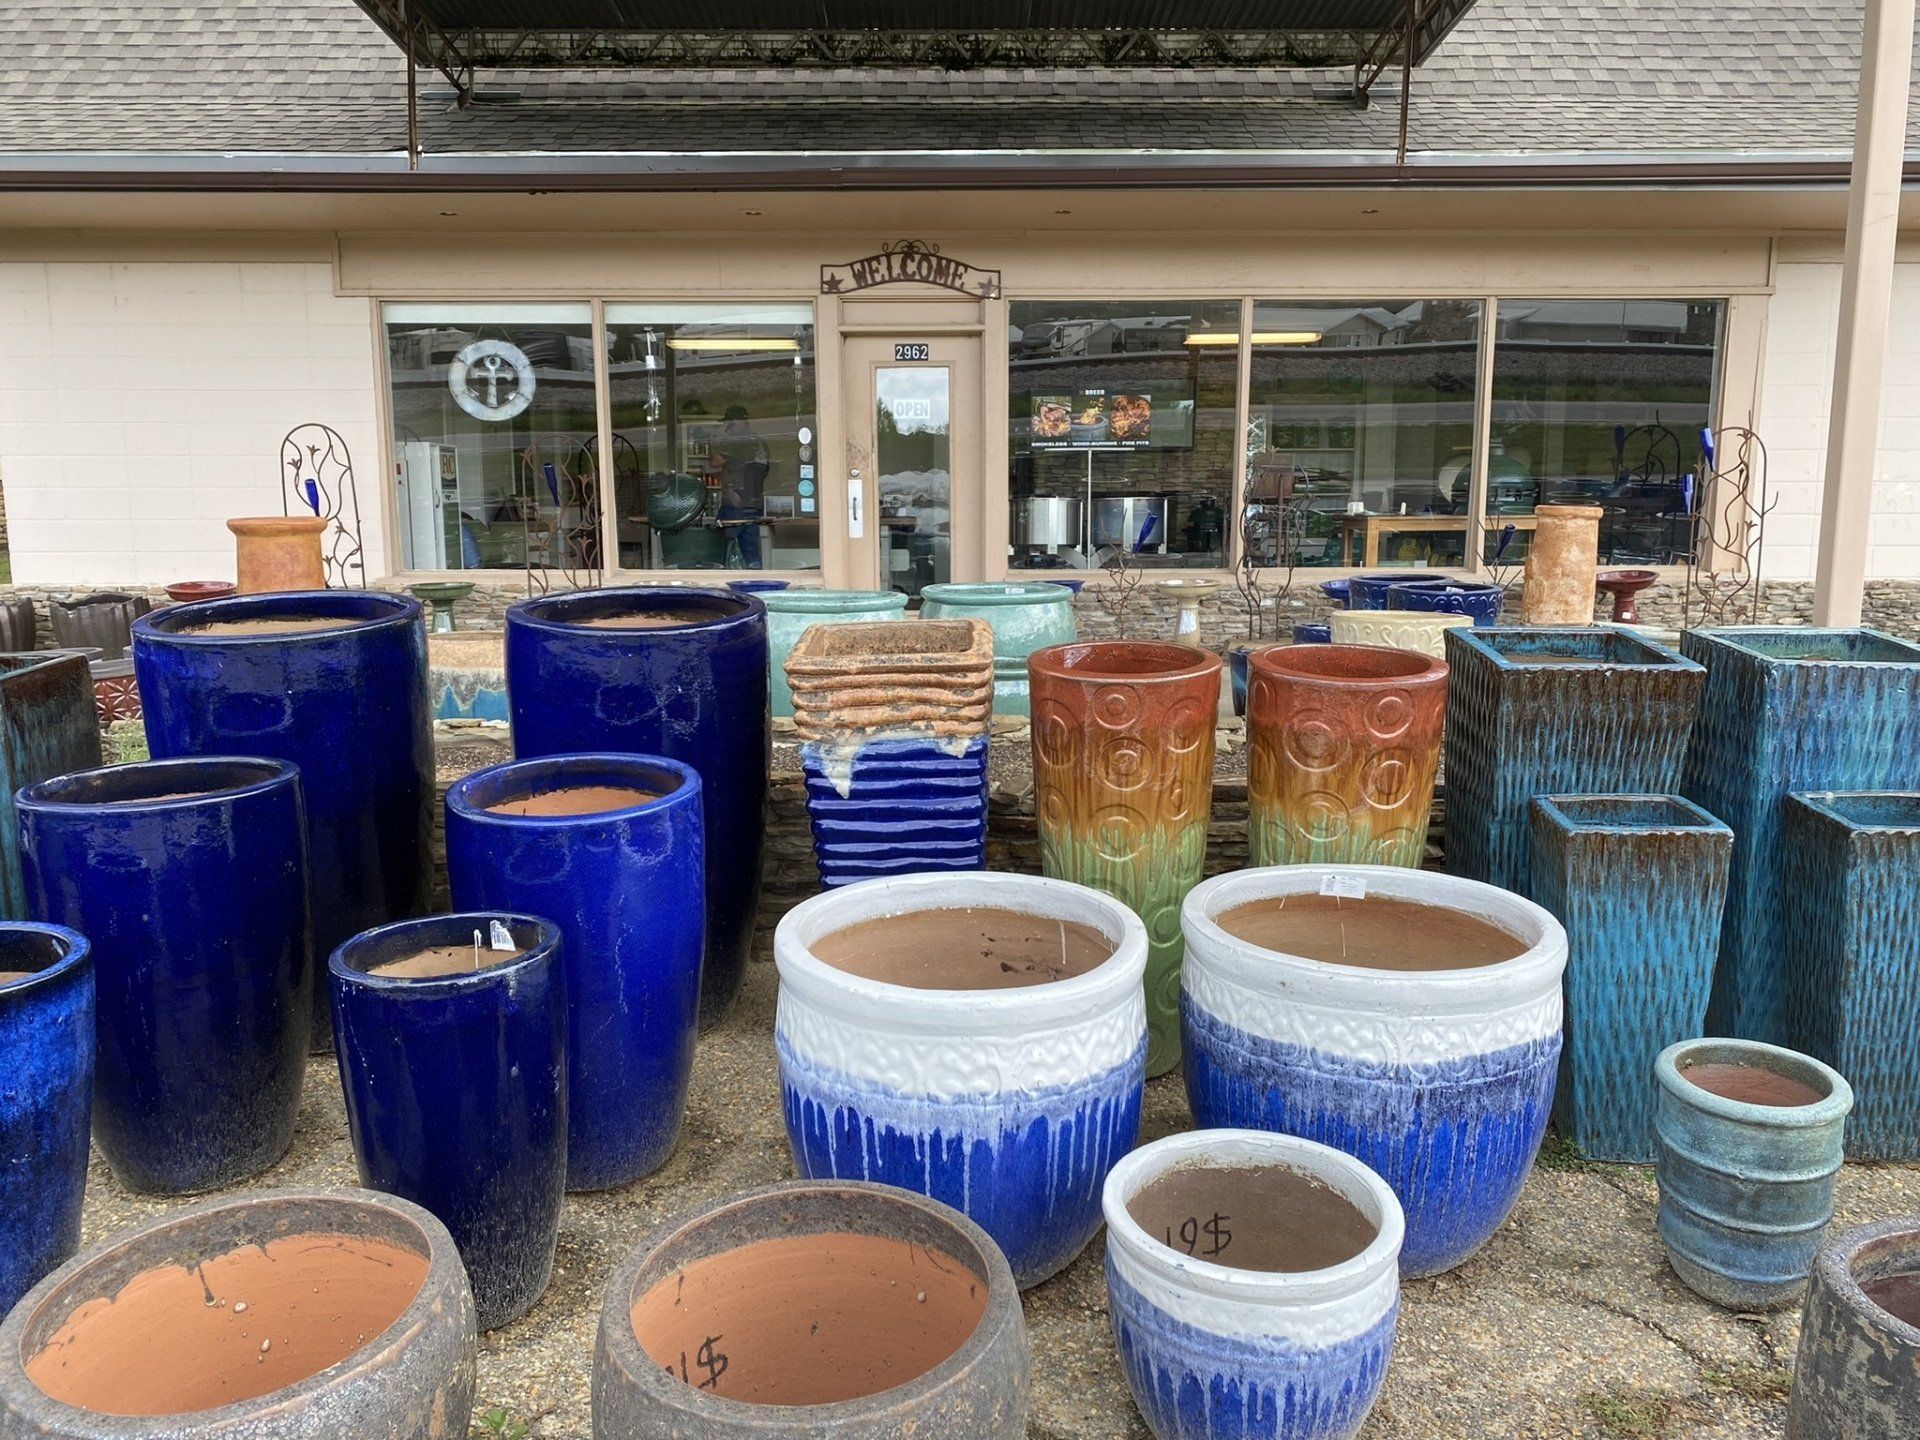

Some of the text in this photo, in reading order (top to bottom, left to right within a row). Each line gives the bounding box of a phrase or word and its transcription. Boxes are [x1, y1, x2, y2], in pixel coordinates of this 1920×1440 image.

[851, 252, 969, 290] WELCOME
[895, 345, 928, 359] 2962
[895, 401, 928, 417] OPEN
[1166, 1212, 1232, 1256] 19$
